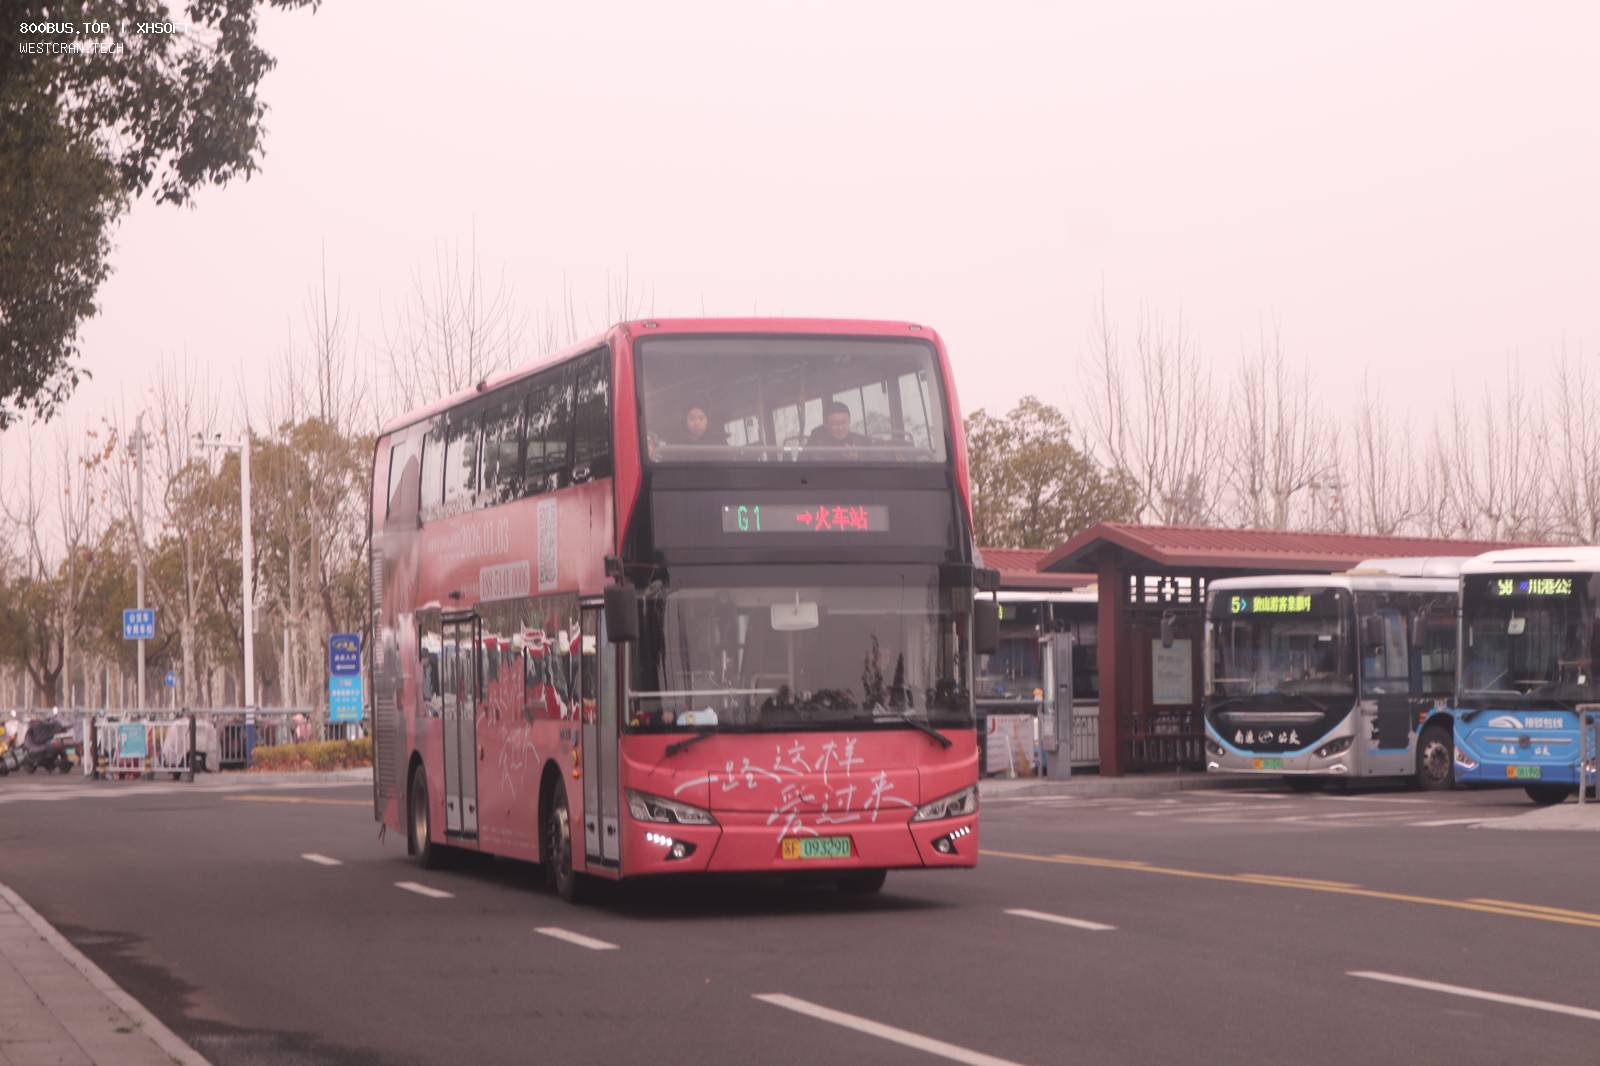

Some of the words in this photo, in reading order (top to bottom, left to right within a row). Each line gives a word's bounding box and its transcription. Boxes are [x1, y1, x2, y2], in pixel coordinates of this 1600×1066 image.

[737, 505, 761, 532] G1
[815, 505, 868, 532] 火车站
[1528, 579, 1572, 594] 川港公
[1231, 596, 1241, 613] 5
[673, 737, 865, 796] 一路这样
[766, 770, 919, 844] 爱过来
